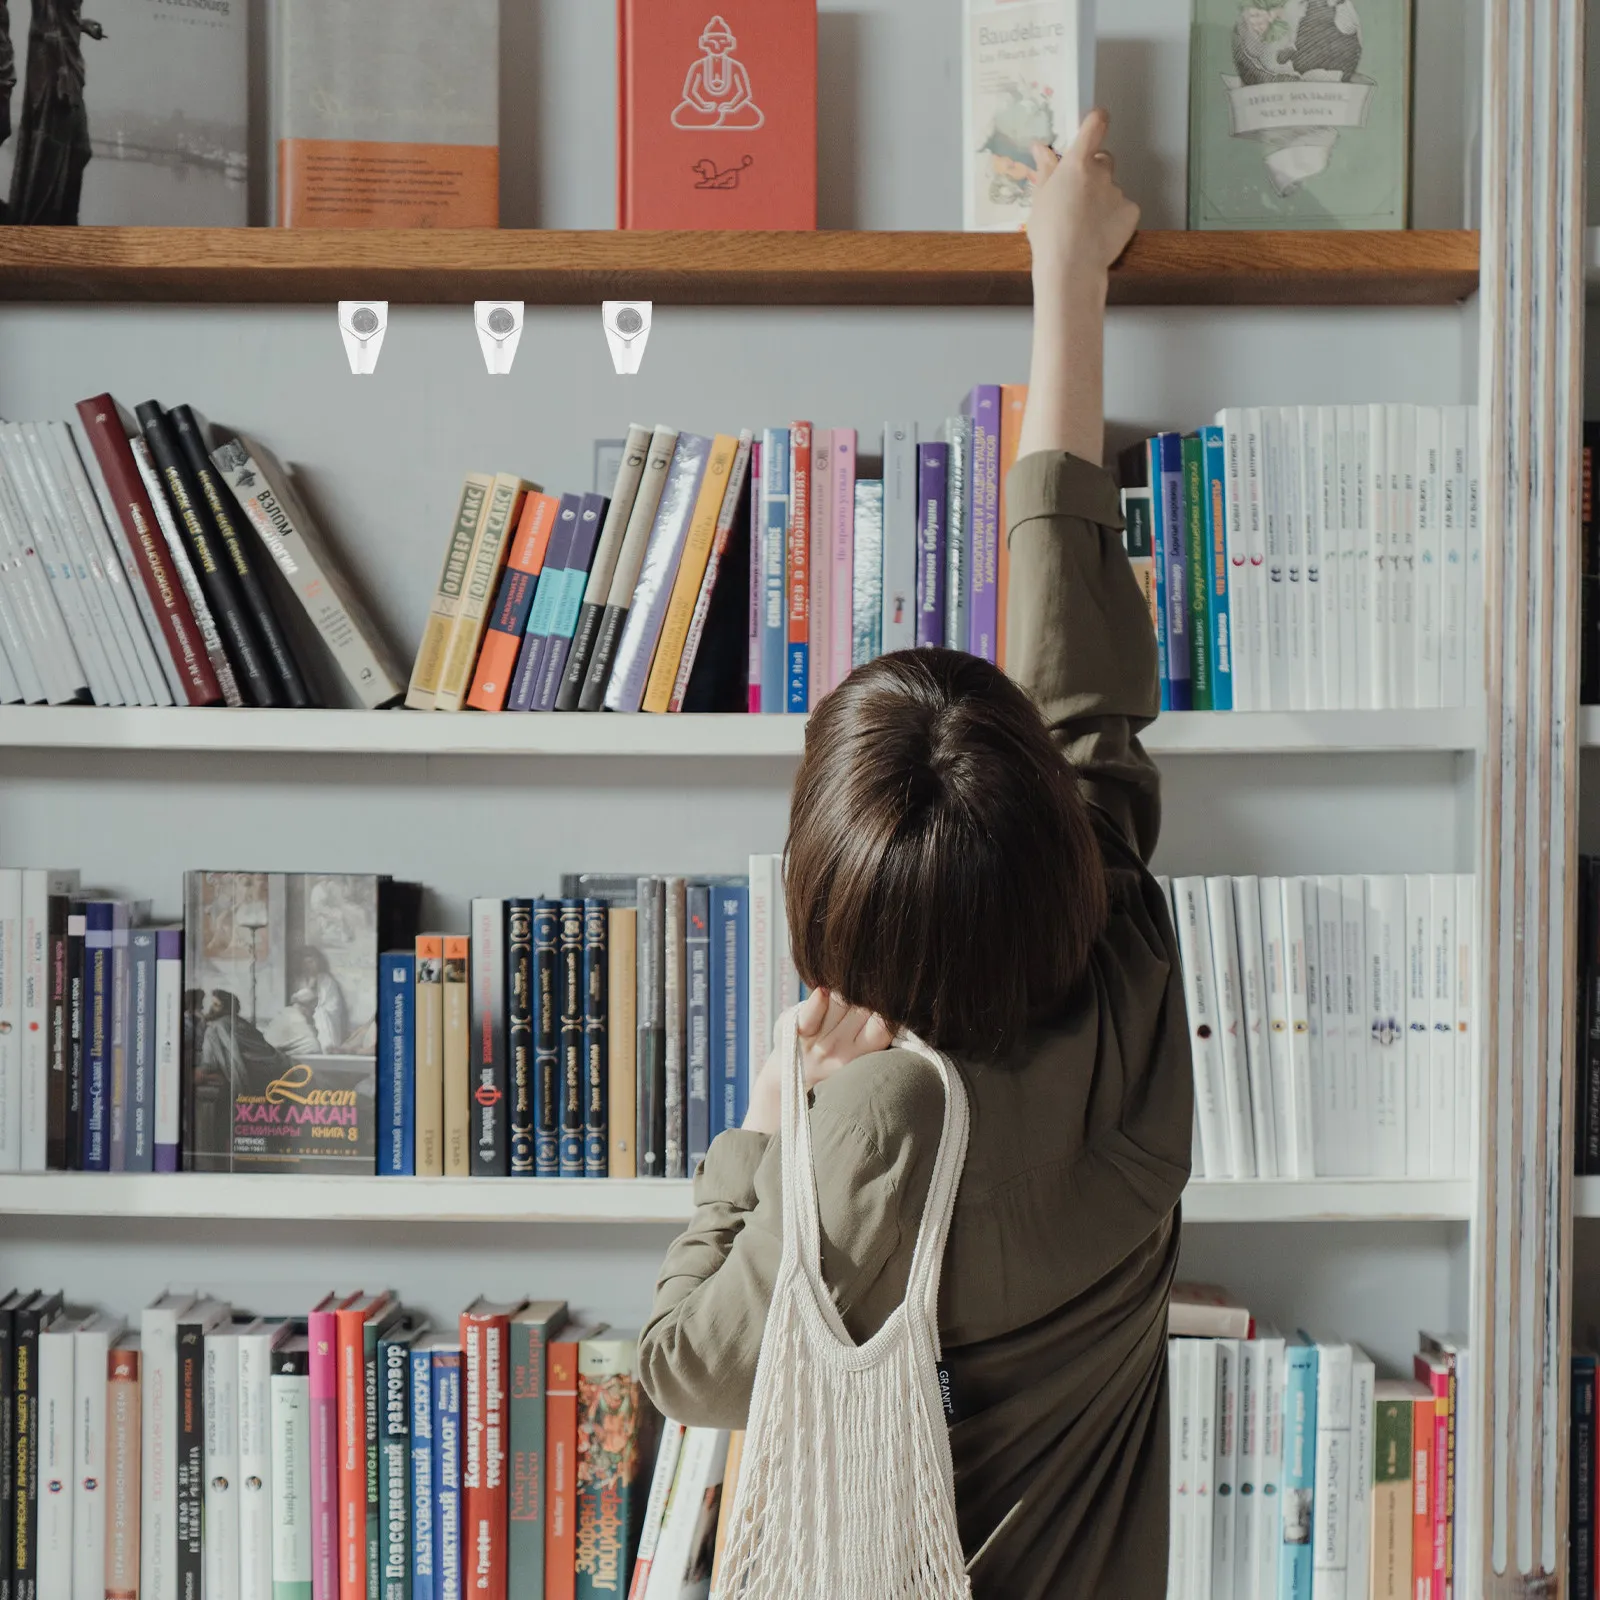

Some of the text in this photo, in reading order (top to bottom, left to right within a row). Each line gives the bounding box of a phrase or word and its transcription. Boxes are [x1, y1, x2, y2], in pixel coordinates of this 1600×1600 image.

[979, 21, 1065, 46] Baudelaire
[163, 465, 191, 510] ЖИЗНИ
[197, 469, 222, 512] ЖИЗНИ
[973, 424, 987, 505] АКЦЕНТУАЦИИ
[984, 434, 997, 510] ПОДРОСТКОВ
[182, 509, 202, 535] ДЛЯ
[216, 512, 233, 537] ДЛЯ
[256, 489, 293, 537] ВЗЛОМ
[443, 533, 470, 592] ОЛИВЕР
[460, 488, 481, 527] САКС
[792, 469, 807, 565] отношениях
[138, 533, 178, 607] ПСИХОЛОГИЯ
[192, 534, 218, 573] МИФЫ
[226, 537, 249, 574] МИФЫ
[472, 491, 510, 595] ОЛИВЕР САКС
[765, 526, 782, 575] КРИЗИСЕ
[972, 517, 985, 592] ПСИХОПАТИИ
[983, 521, 996, 584] ХАРАКТЕРА
[789, 584, 804, 621] Гнев
[923, 552, 937, 612] Рождение
[26, 975, 35, 1008] СЛОВАРЬ
[136, 959, 146, 1014] СНОВИДЕНИЙ
[135, 1065, 145, 1102] СЛОВАРЬ
[265, 1063, 356, 1106] Lacan
[391, 992, 404, 1170] КРАТКИЙ ПСИХОЛОГИЧЕСКИЙ СЛОВАРЬ
[689, 1068, 705, 1100] Джойс
[234, 1104, 358, 1126] ЖАК ЛАКАН
[234, 1125, 302, 1137] СЕМИНАРЫ
[311, 1126, 344, 1138] КНИГА
[16, 1344, 28, 1390] ВРЕМЕНИ
[183, 1357, 193, 1386] СТРЕССА
[484, 1326, 508, 1411] практики
[510, 1364, 525, 1398] Сон
[524, 1328, 542, 1398] Бодлера
[16, 1393, 28, 1433] НАШЕГО
[152, 1367, 162, 1420] СТРЕССА
[365, 1360, 376, 1440] УКРОТИТЕЛЬ
[463, 1324, 485, 1488] Коммуникация:
[16, 1436, 28, 1487] ЛИЧНОСТЬ
[151, 1422, 164, 1501] ПСИХОЛОГИЯ
[282, 1419, 296, 1526] Конфликтология
[366, 1444, 378, 1503] ТРОЛЛЕЙ
[382, 1343, 409, 1578] Повседневный разговор
[411, 1357, 432, 1575] РАЗГОВОРНЫЙ ДИСКУРС
[440, 1416, 458, 1488] ДИАЛОГ
[484, 1426, 501, 1488] теории
[114, 1389, 127, 1579] ТЕРАПИЯ ЭМОЦИОНАЛЬНЫХ СХЕМ
[509, 1450, 525, 1521] Роберто
[524, 1451, 538, 1521] Калассо
[16, 1489, 28, 1570] НЕВРОТИЧЕСКАЯ
[476, 1519, 492, 1574] Гриффин
[572, 1492, 604, 1575] Эффект
[368, 1560, 378, 1599] КАРСОН
